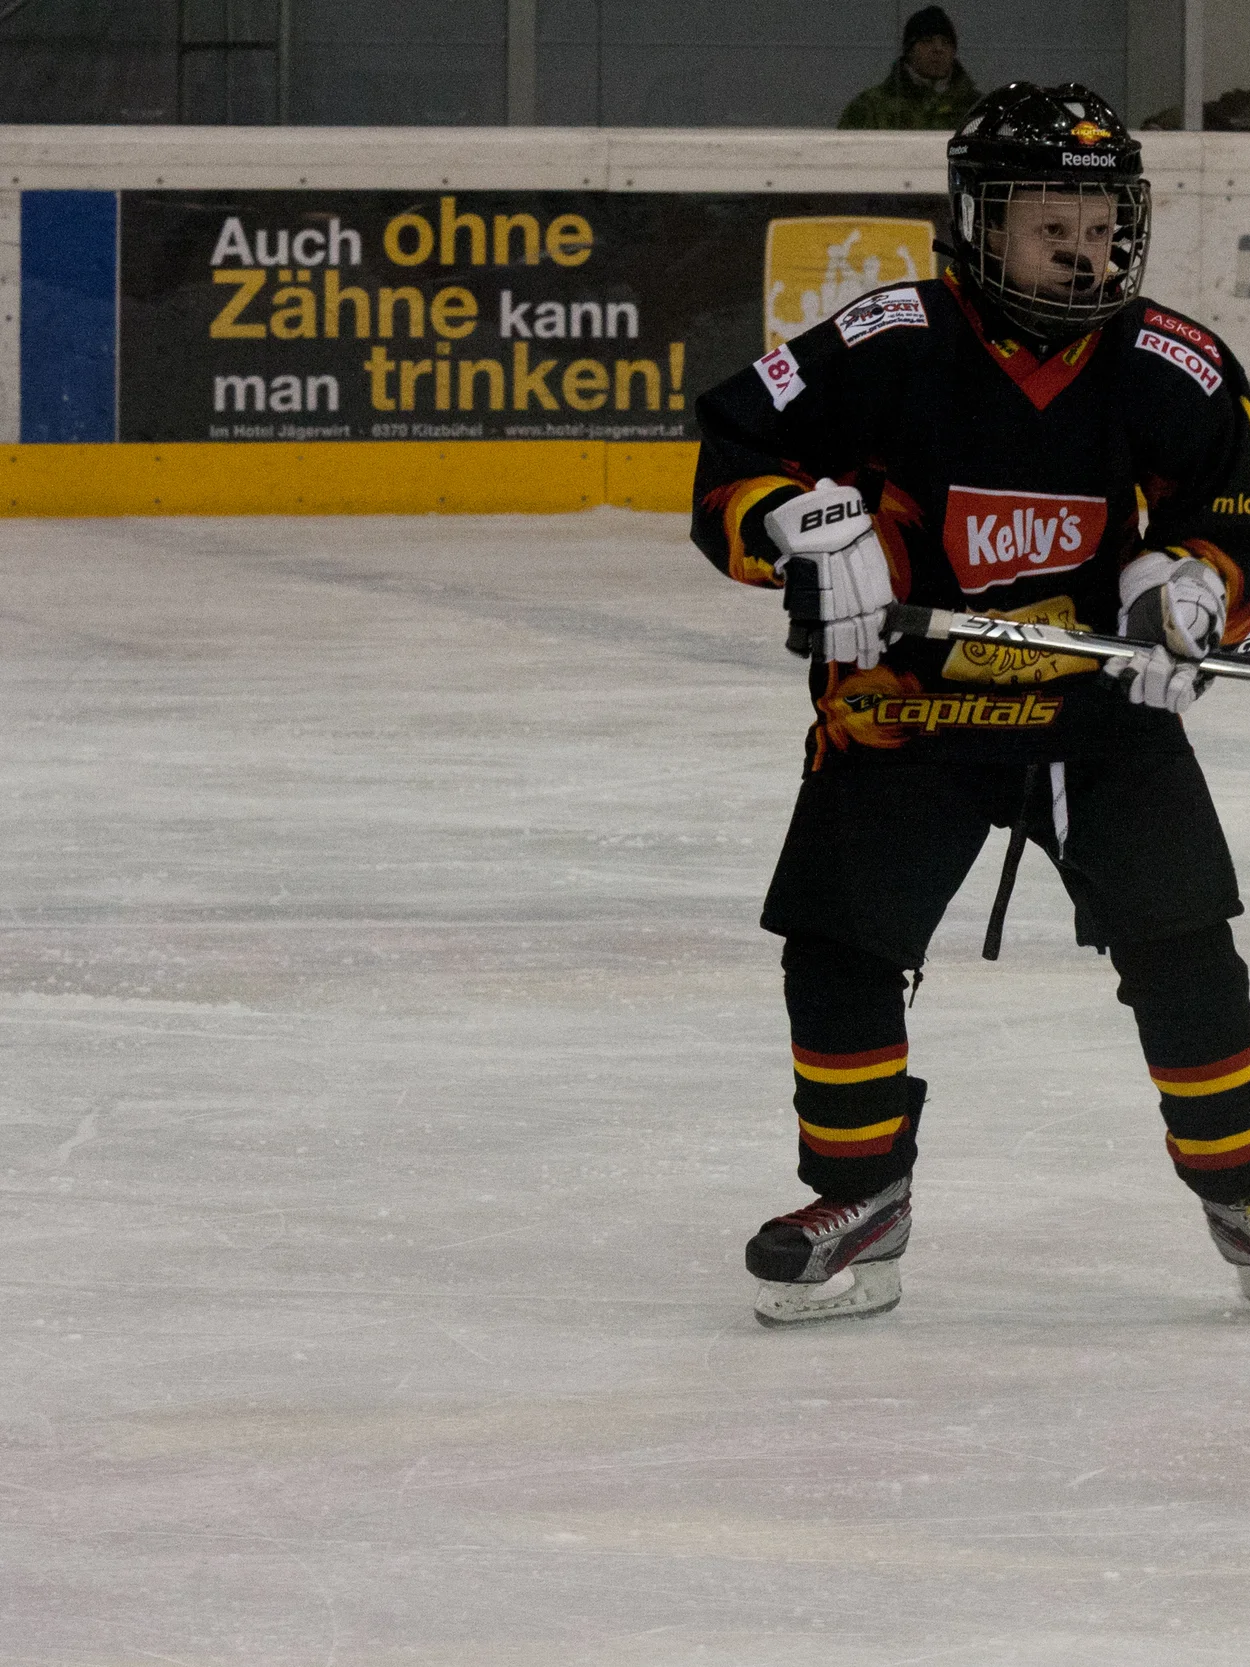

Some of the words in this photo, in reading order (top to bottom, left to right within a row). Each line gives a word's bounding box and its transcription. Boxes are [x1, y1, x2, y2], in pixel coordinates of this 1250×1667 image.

[1062, 152, 1117, 167] Reebok
[210, 217, 362, 266] Auch
[383, 197, 594, 267] ohne
[209, 268, 479, 339] Zähne
[501, 290, 639, 339] kann
[213, 374, 339, 412] man
[364, 341, 686, 412] trinken!
[1141, 333, 1219, 390] RICOH
[233, 424, 274, 438] Hotel
[966, 507, 1082, 566] Kelly's
